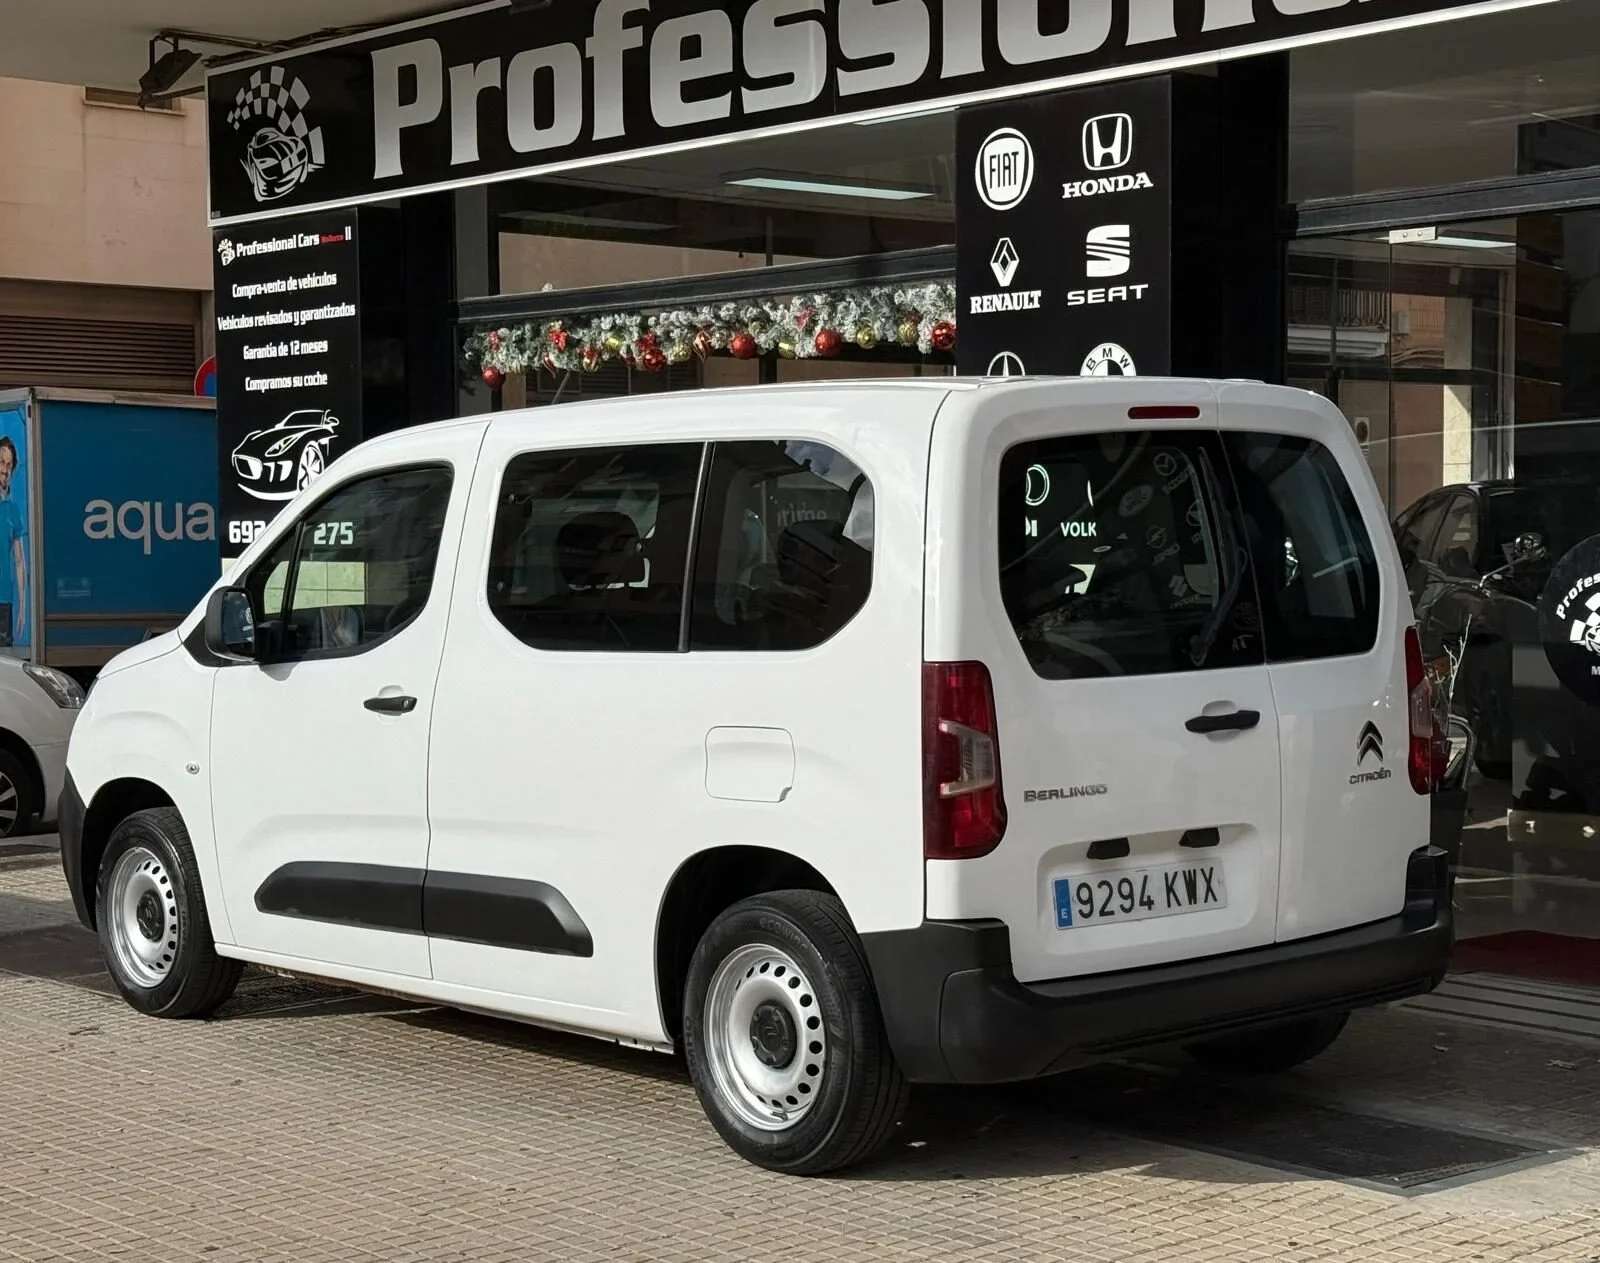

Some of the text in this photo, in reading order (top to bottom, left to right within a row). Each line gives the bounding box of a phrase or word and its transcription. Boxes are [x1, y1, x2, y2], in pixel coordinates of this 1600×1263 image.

[989, 151, 1019, 189] FIAT
[1062, 172, 1154, 199] HONDA
[236, 234, 297, 257] Professional
[297, 233, 320, 248] Cars
[232, 272, 337, 299] Compra-venta de vehículos
[1067, 284, 1148, 306] SEAT
[970, 290, 1041, 314] RENAULT
[217, 302, 356, 331] Vehículos revisados y garantizados
[243, 340, 328, 360] Garantía de 12 meses
[1086, 347, 1131, 371] BMW
[245, 371, 328, 393] Compramos su coche
[83, 499, 216, 555] aqua
[313, 522, 353, 544] 275
[1023, 784, 1108, 802] BERLINGO
[1076, 867, 1218, 919] 9294 KWX
[1061, 908, 1068, 919] E
